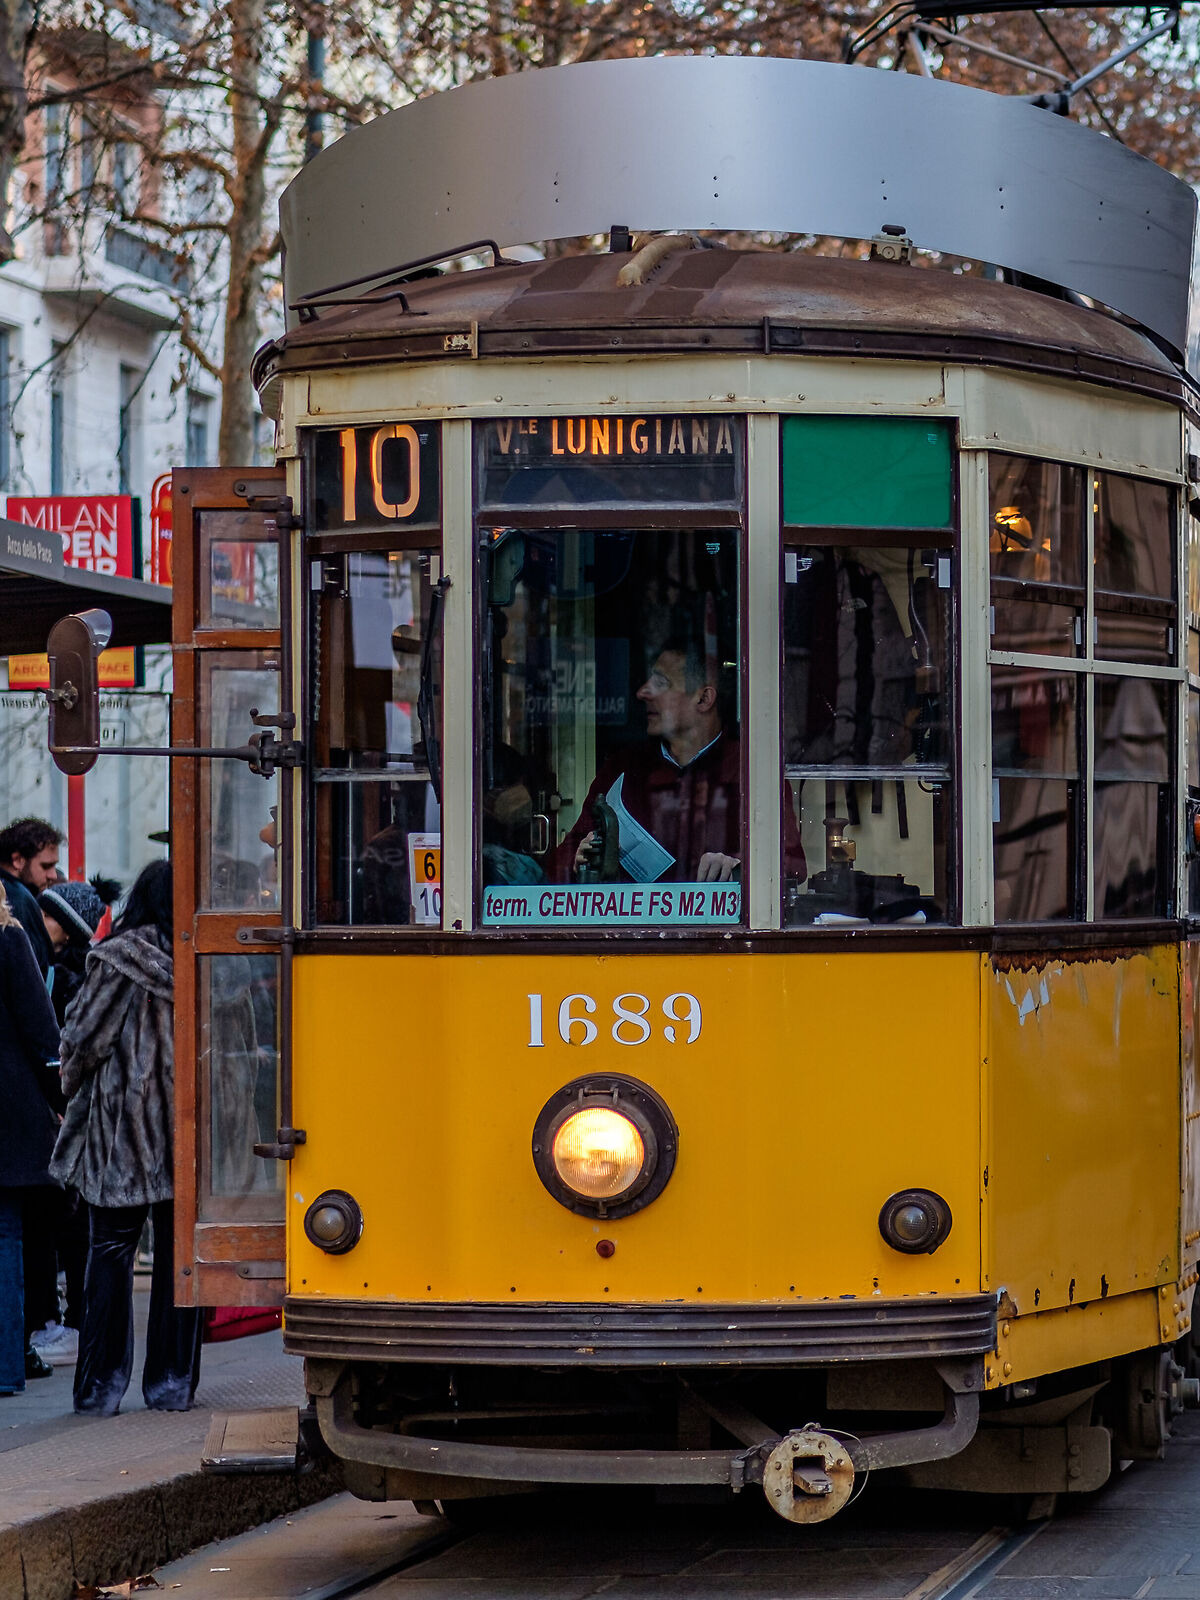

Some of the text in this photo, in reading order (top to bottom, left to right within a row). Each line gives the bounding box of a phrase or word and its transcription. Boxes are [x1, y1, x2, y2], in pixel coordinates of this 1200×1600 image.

[552, 418, 733, 455] LUNIGIANA
[340, 424, 420, 521] 10
[21, 503, 118, 531] MILAN
[8, 535, 53, 564] Arco della Pace
[424, 852, 436, 881] 6
[486, 891, 737, 917] term. CENTRALE FS M2 M3
[527, 992, 702, 1047] 1689
